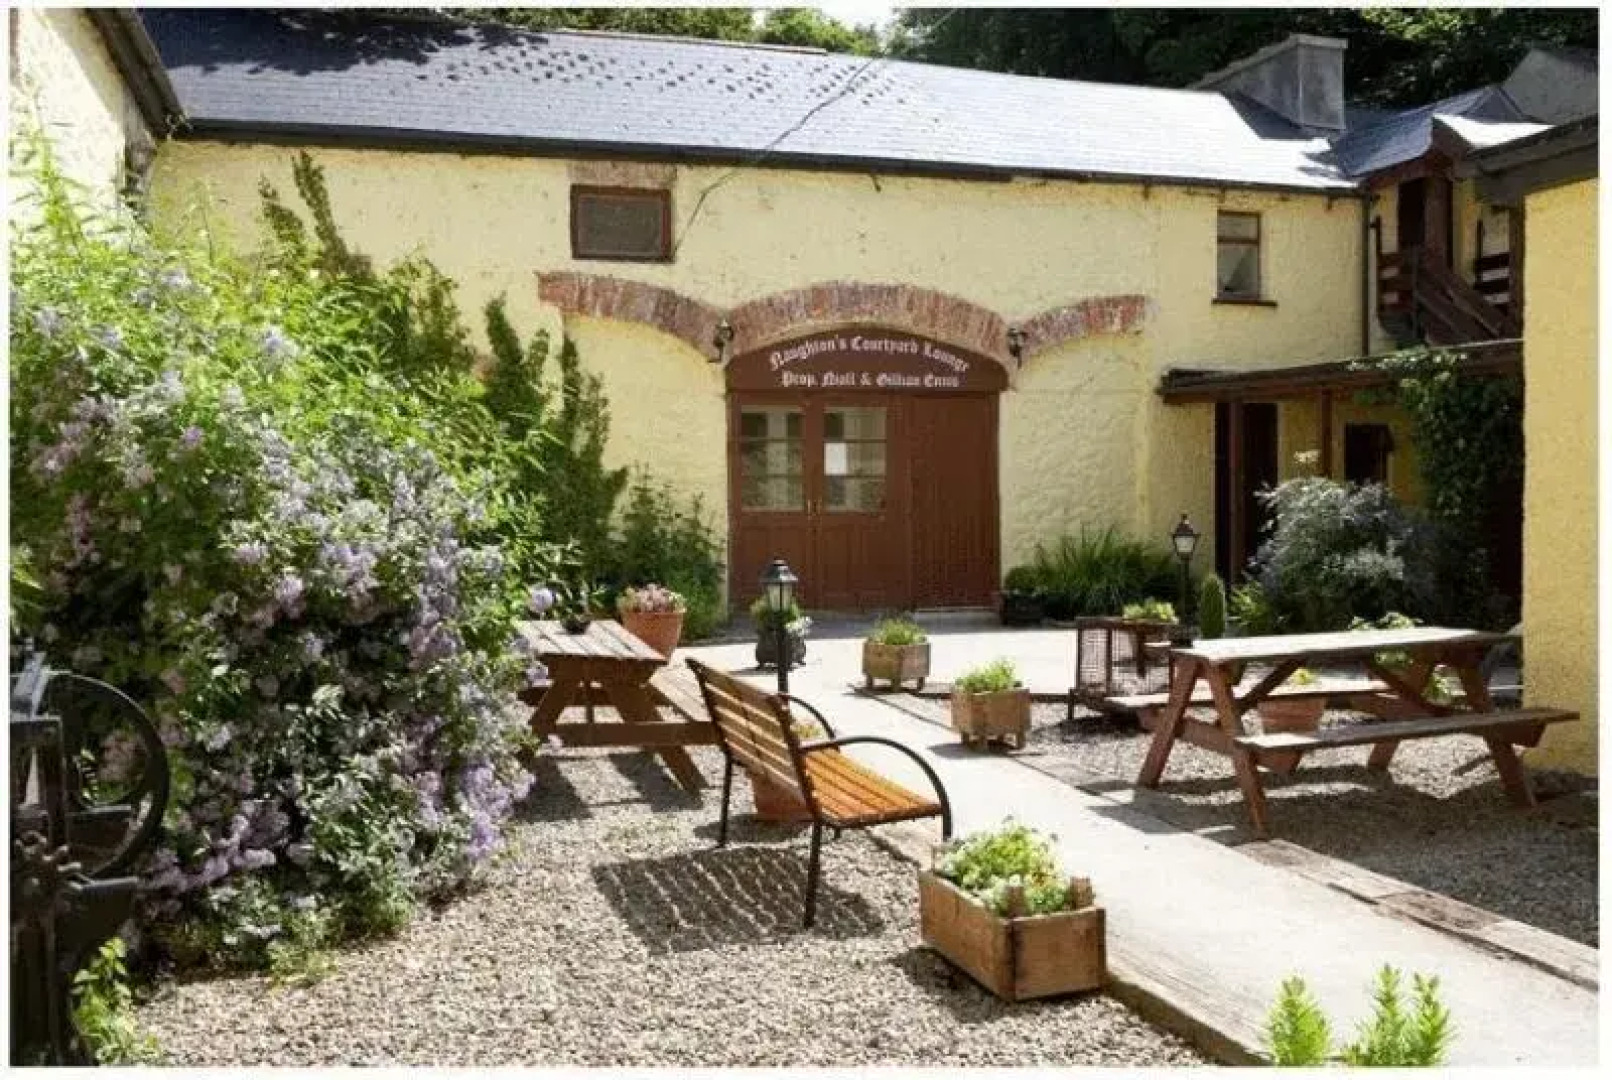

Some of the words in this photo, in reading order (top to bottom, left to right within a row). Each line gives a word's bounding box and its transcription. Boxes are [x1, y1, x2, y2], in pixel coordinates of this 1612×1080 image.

[851, 336, 919, 354] Courtyard
[924, 341, 970, 372] Lounge
[861, 372, 872, 386] &
